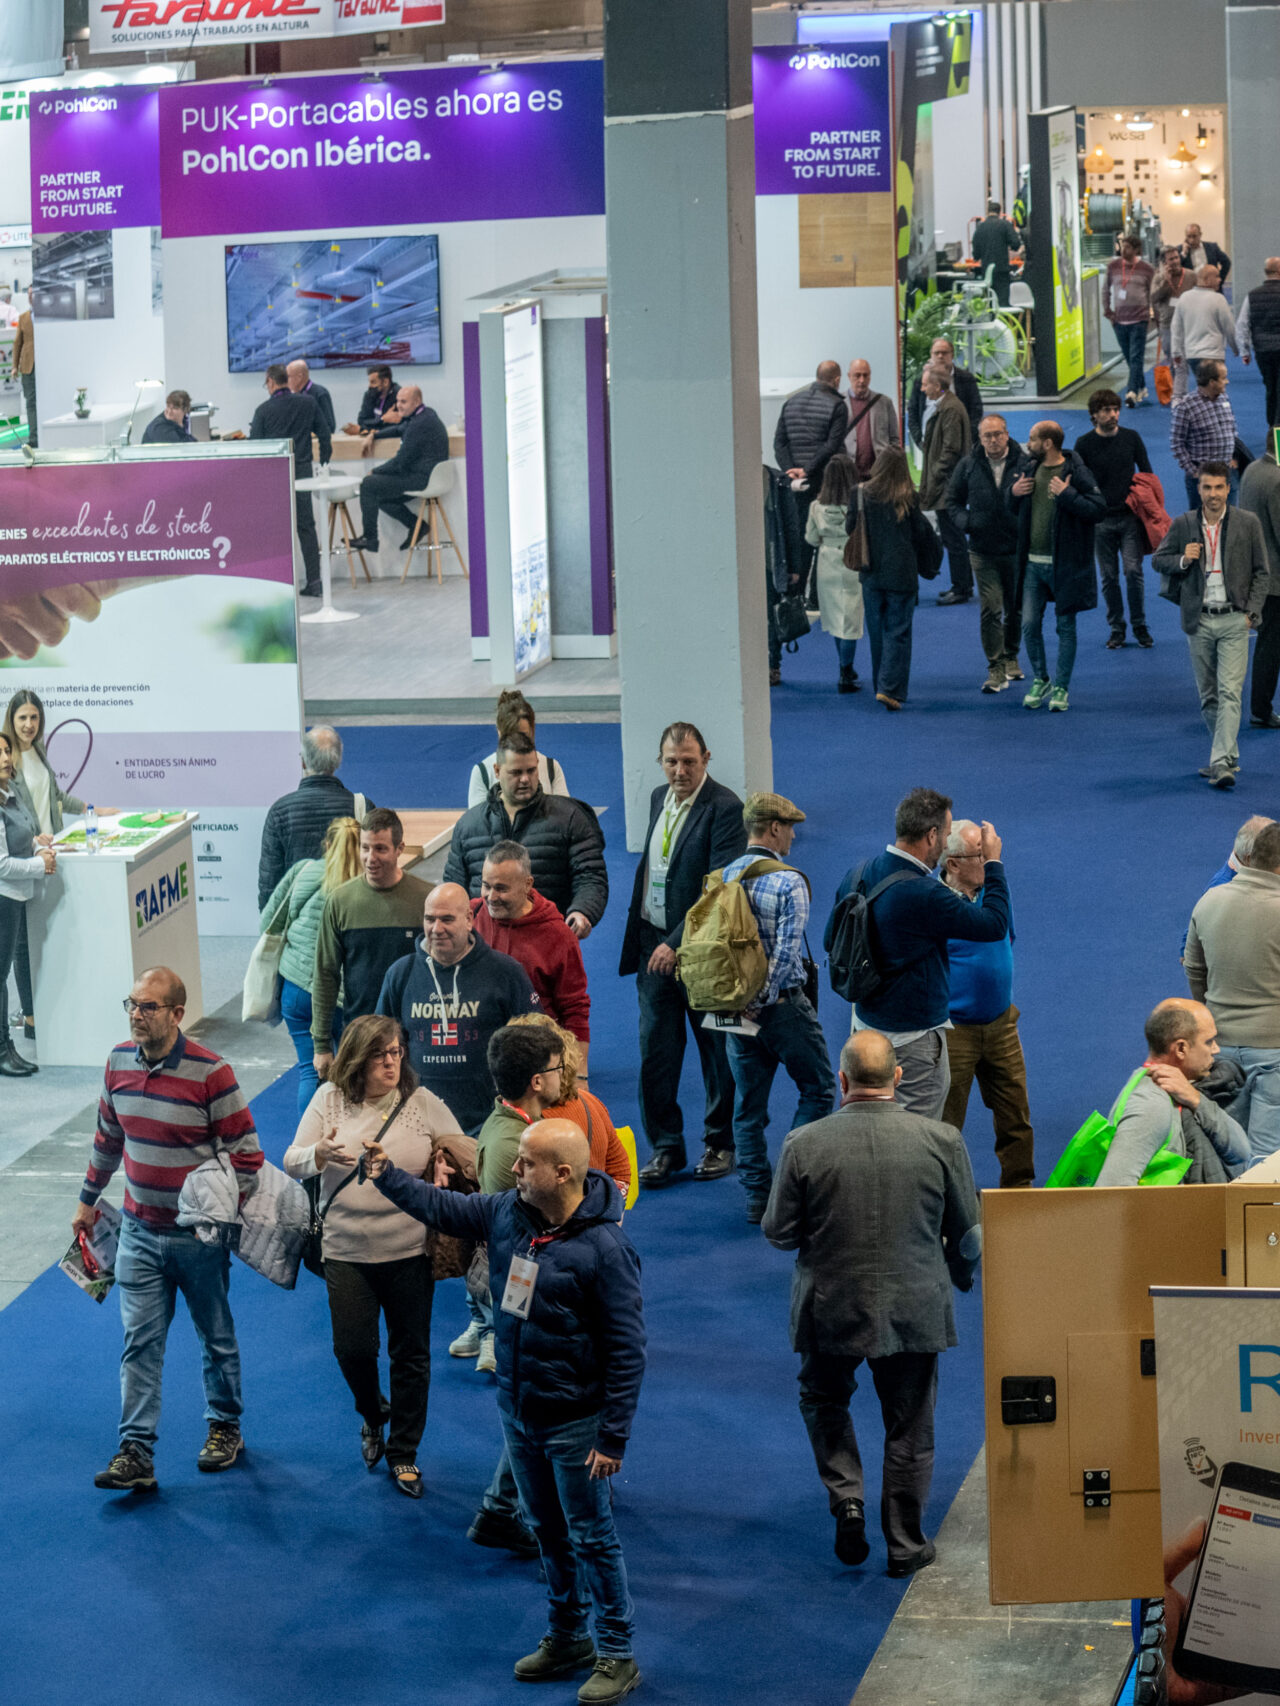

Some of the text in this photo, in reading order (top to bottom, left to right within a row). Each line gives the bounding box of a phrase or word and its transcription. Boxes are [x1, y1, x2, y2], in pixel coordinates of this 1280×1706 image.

[112, 20, 310, 43] SOLUCIONES PARA TRABAJOS EN ALTURA
[807, 53, 881, 70] PohlCon
[55, 98, 118, 114] PohlCon
[181, 88, 563, 134] PUK-Portacables ahora es
[810, 130, 881, 144] PARTNER
[181, 135, 432, 175] PohlCon Ibérica.
[784, 147, 881, 162] FROM START
[40, 171, 101, 187] PARTNER
[793, 164, 881, 178] TO FUTURE.
[40, 185, 124, 203] FROM START
[40, 202, 117, 219] TO FUTURE.
[0, 499, 213, 541] ENES excedentes de stock
[50, 550, 116, 565] ELÉCTRICOS
[117, 551, 125, 562] Y
[127, 547, 210, 562] ELECTRÓNICOS
[212, 536, 232, 569] ?
[57, 685, 89, 693] materia
[91, 684, 101, 692] de
[103, 684, 150, 694] prevención
[73, 699, 84, 707] de
[85, 698, 134, 707] donaciones
[124, 756, 217, 767] ENTIDADES SIN ÁNIMO
[125, 770, 165, 779] DE LUCRO
[192, 823, 239, 832] NEFICIADAS
[149, 861, 188, 922] AFME
[411, 1001, 480, 1019] NORWAY
[422, 1055, 467, 1063] EXPEDITION
